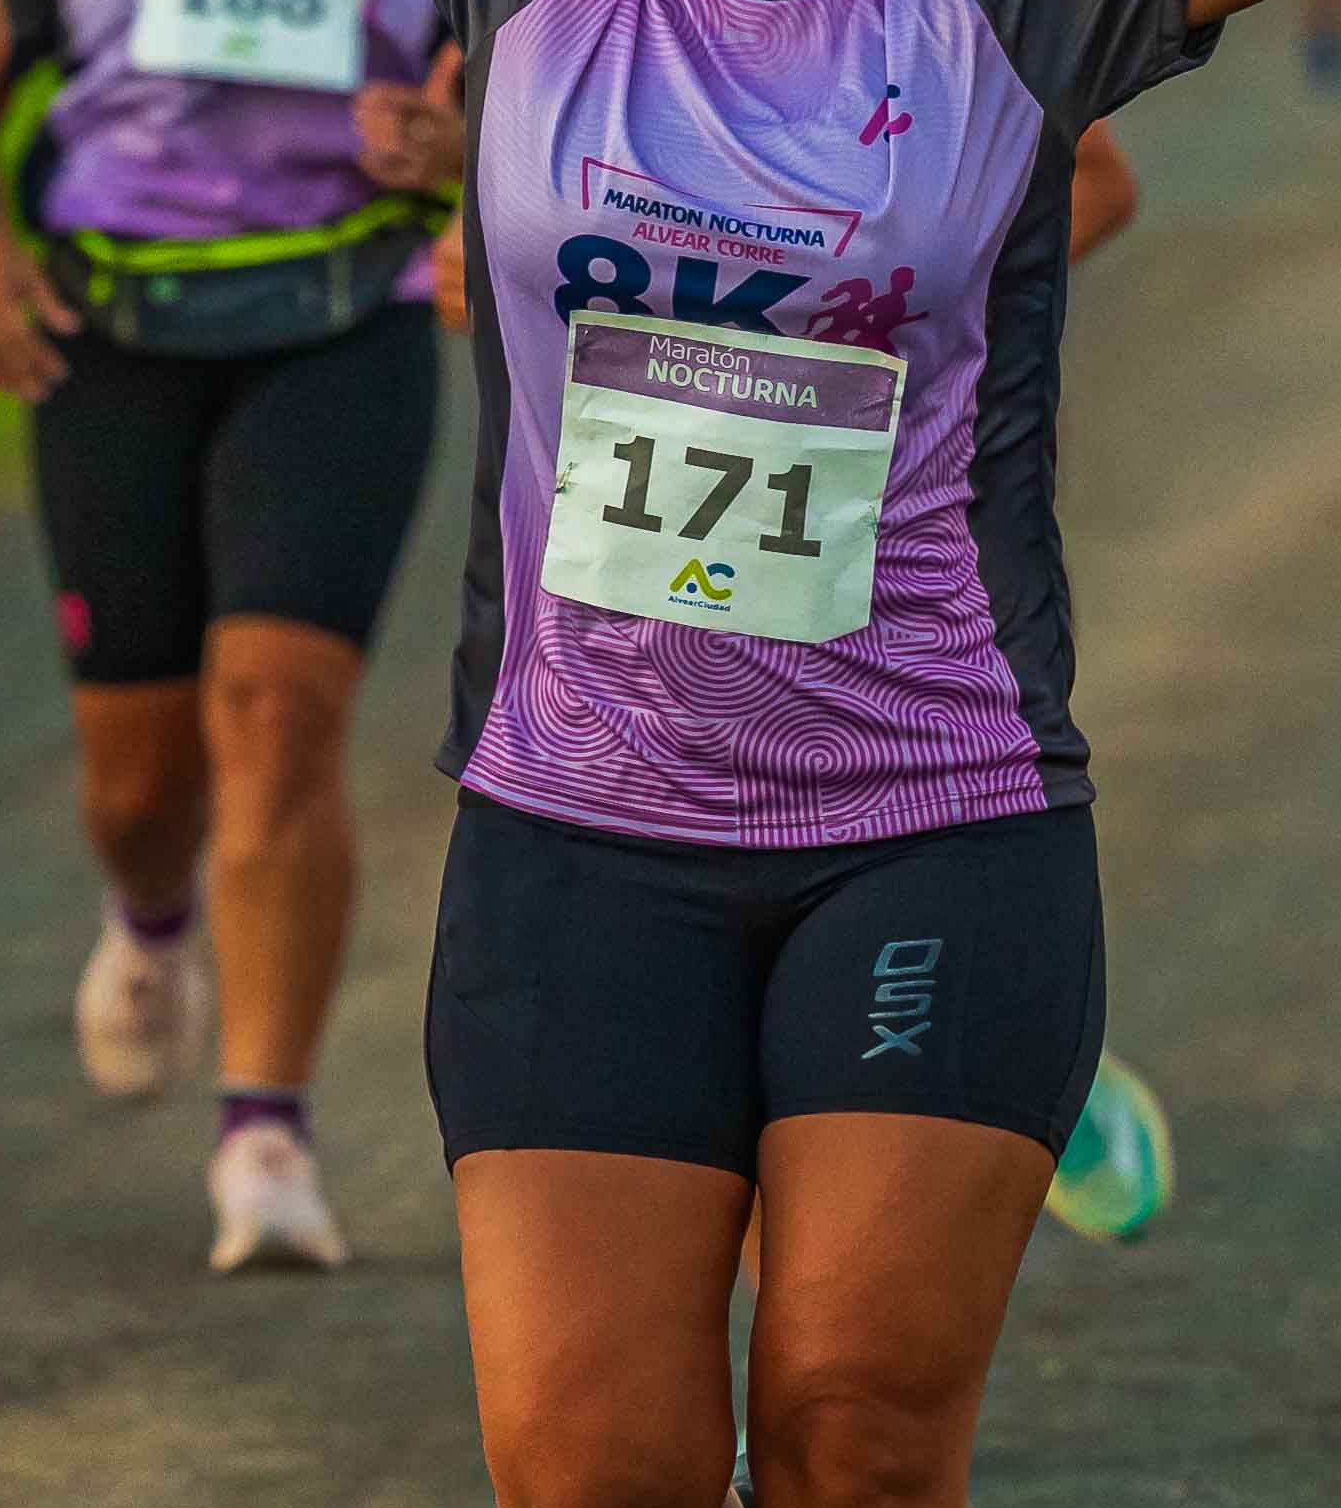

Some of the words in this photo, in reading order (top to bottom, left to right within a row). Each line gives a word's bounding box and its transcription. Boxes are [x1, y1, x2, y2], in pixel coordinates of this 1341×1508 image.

[602, 188, 704, 228] MARATON
[709, 213, 825, 248] NOCTURNA
[632, 222, 711, 253] ALVEAR
[717, 239, 785, 265] CORRE
[554, 234, 812, 336] 8K
[649, 335, 751, 372] Maratón
[646, 358, 819, 409] NOCTURNA
[602, 435, 822, 558] 171
[667, 595, 732, 613] AlvearCiudad
